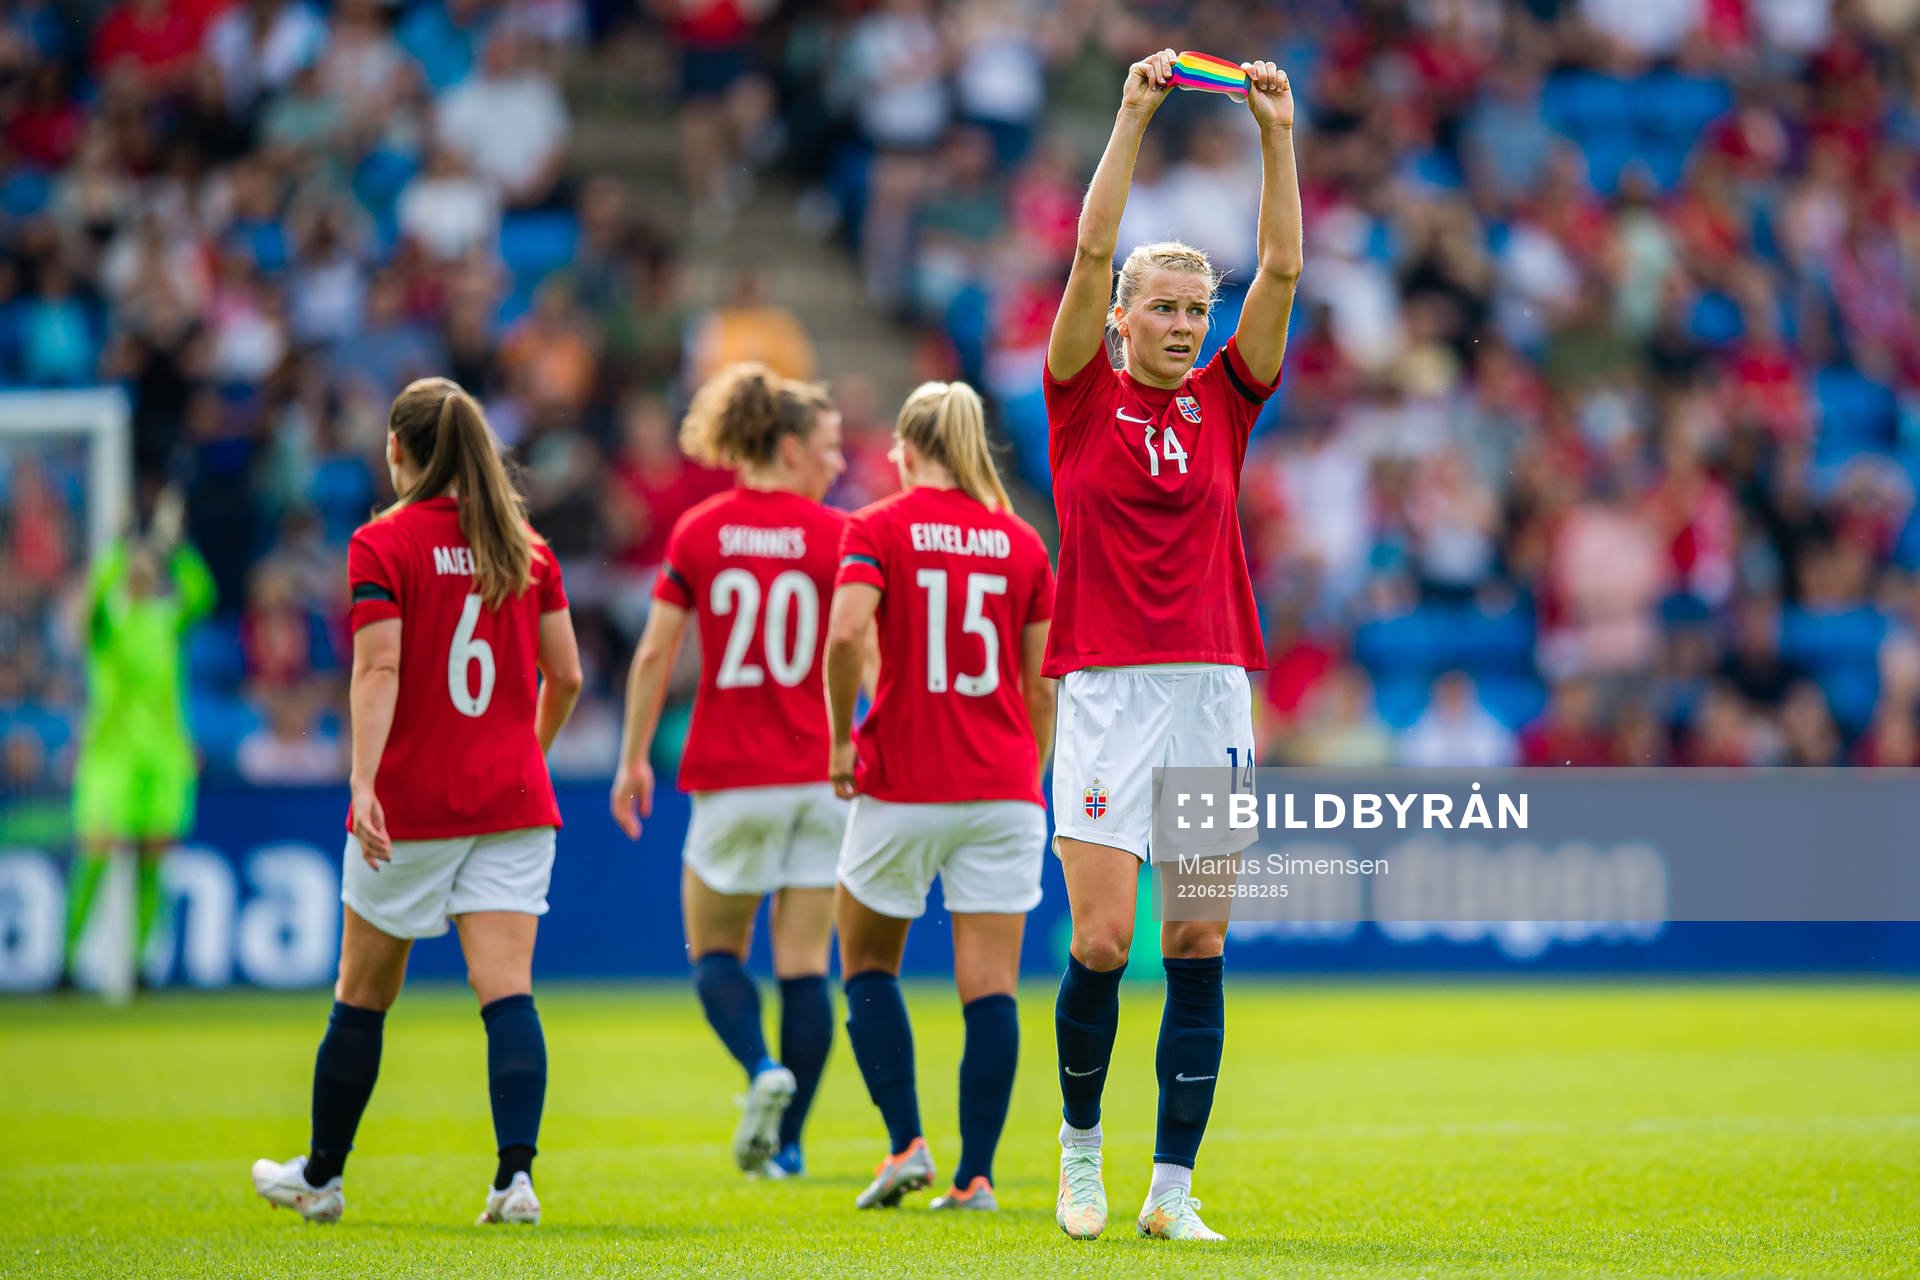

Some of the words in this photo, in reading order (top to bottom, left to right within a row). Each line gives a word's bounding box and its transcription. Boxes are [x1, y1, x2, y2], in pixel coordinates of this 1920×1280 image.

[1145, 425, 1188, 476] 14
[910, 523, 1011, 559] EIKELAND
[448, 594, 496, 717] 6
[710, 568, 819, 690] 20
[916, 569, 1007, 697] 15
